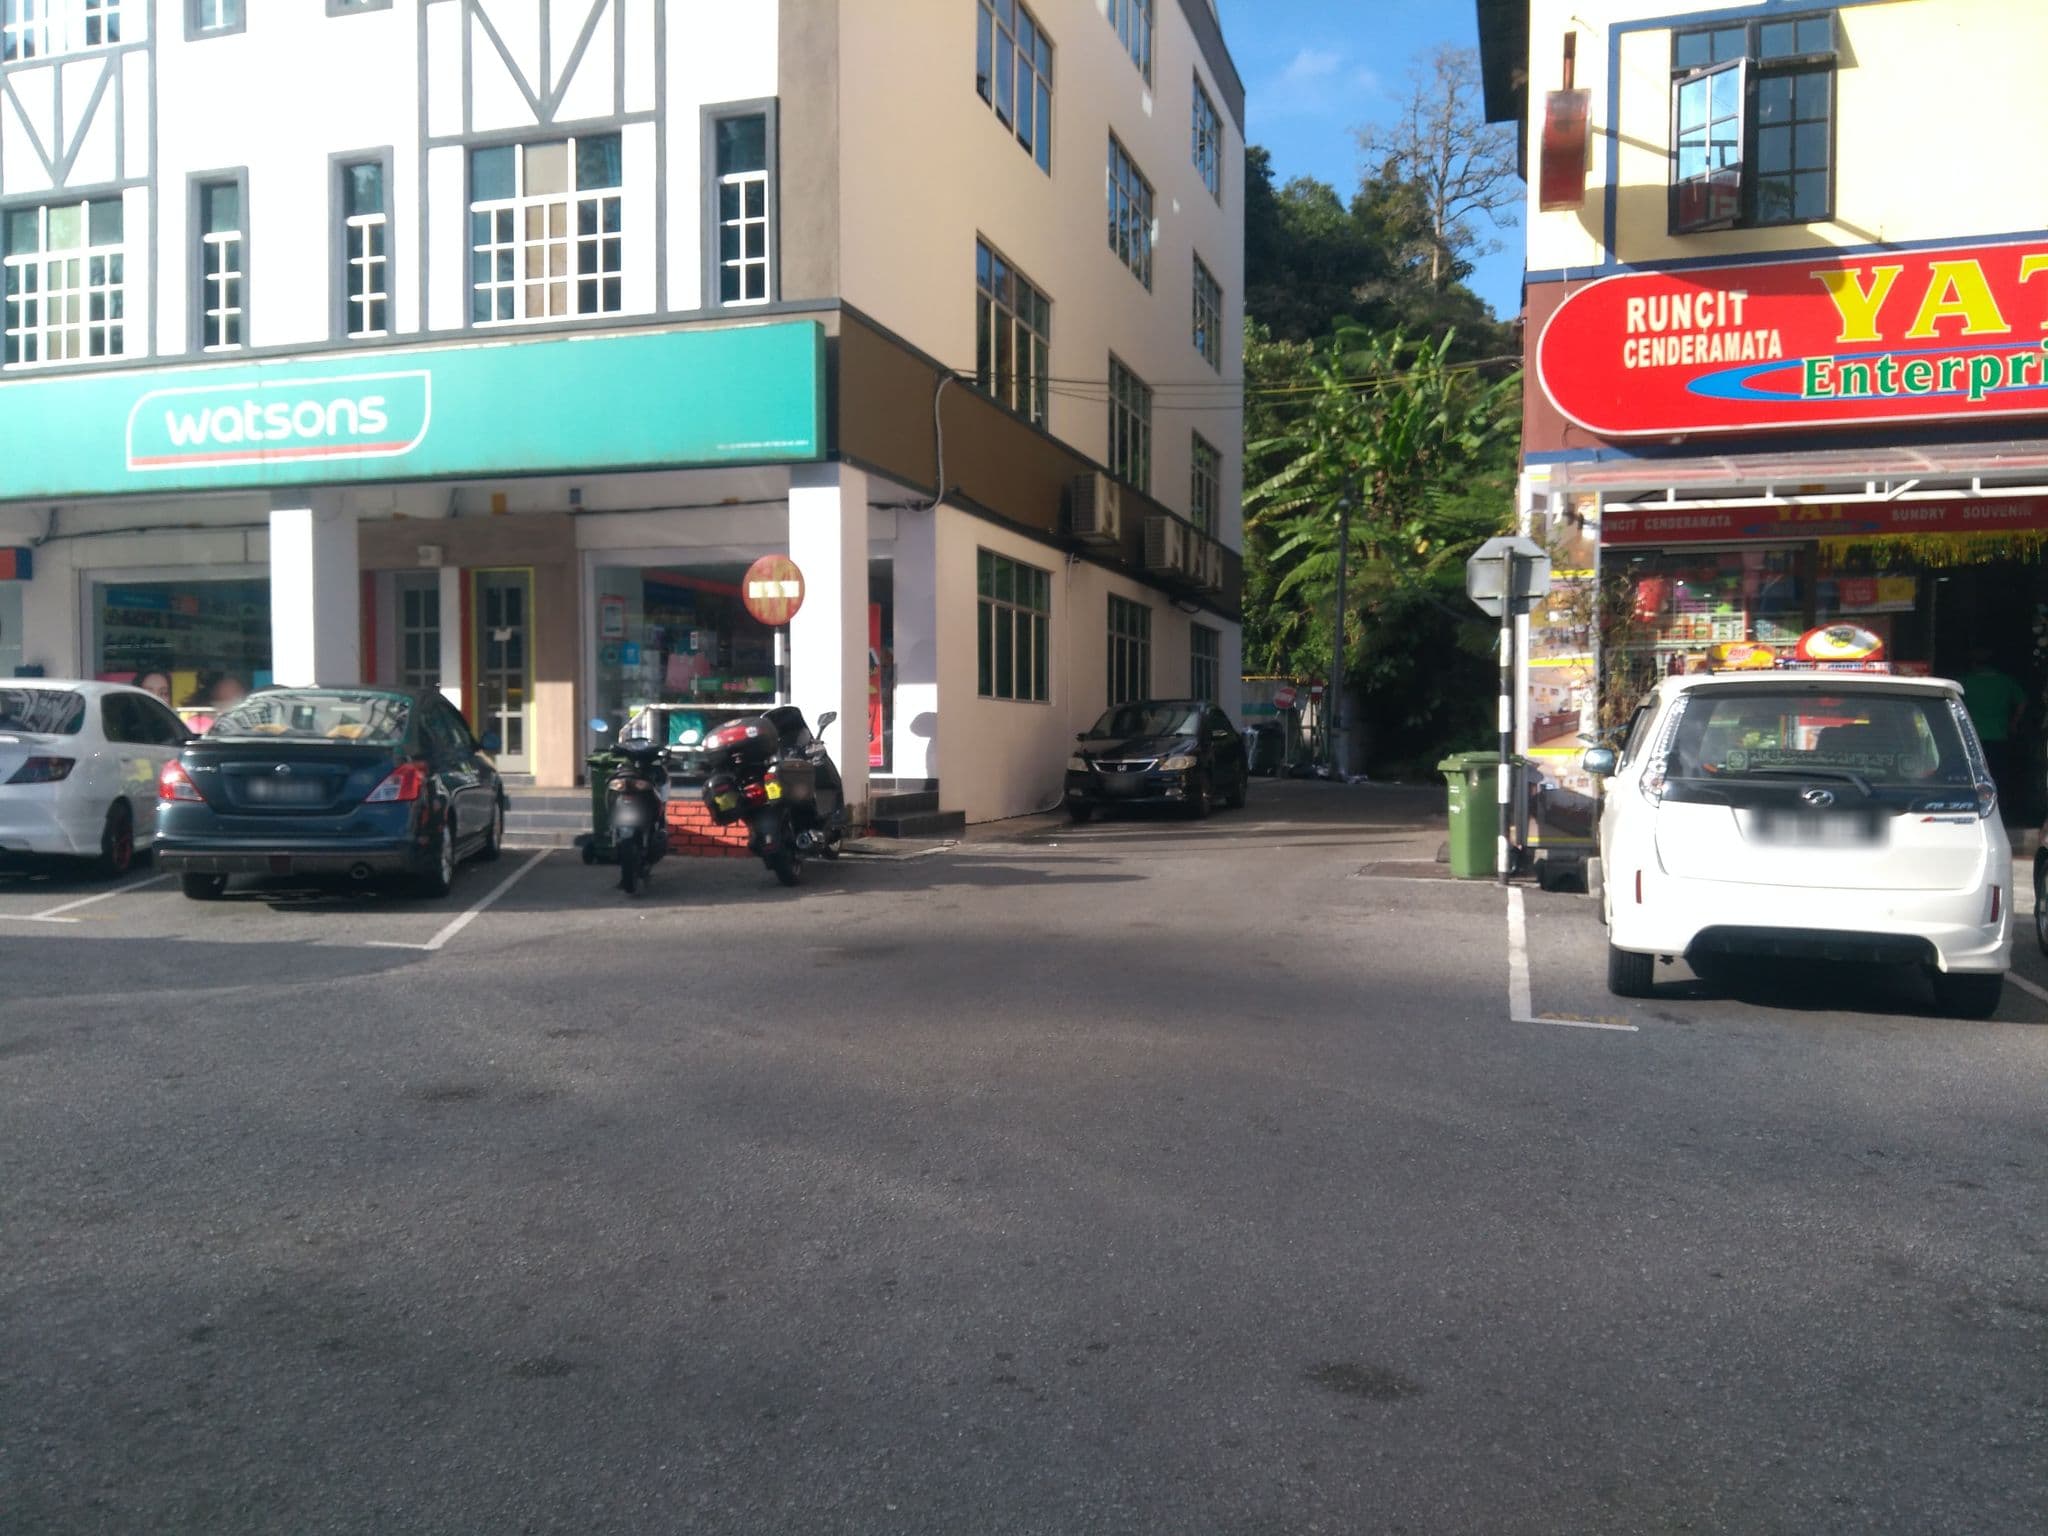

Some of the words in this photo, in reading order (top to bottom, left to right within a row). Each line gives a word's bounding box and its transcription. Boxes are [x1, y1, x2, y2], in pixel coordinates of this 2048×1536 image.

[1627, 289, 1748, 334] RUNCIT
[1624, 329, 1783, 369] CENDERAMATA
[165, 395, 388, 446] watsons
[1892, 507, 1946, 521] SUNDRY
